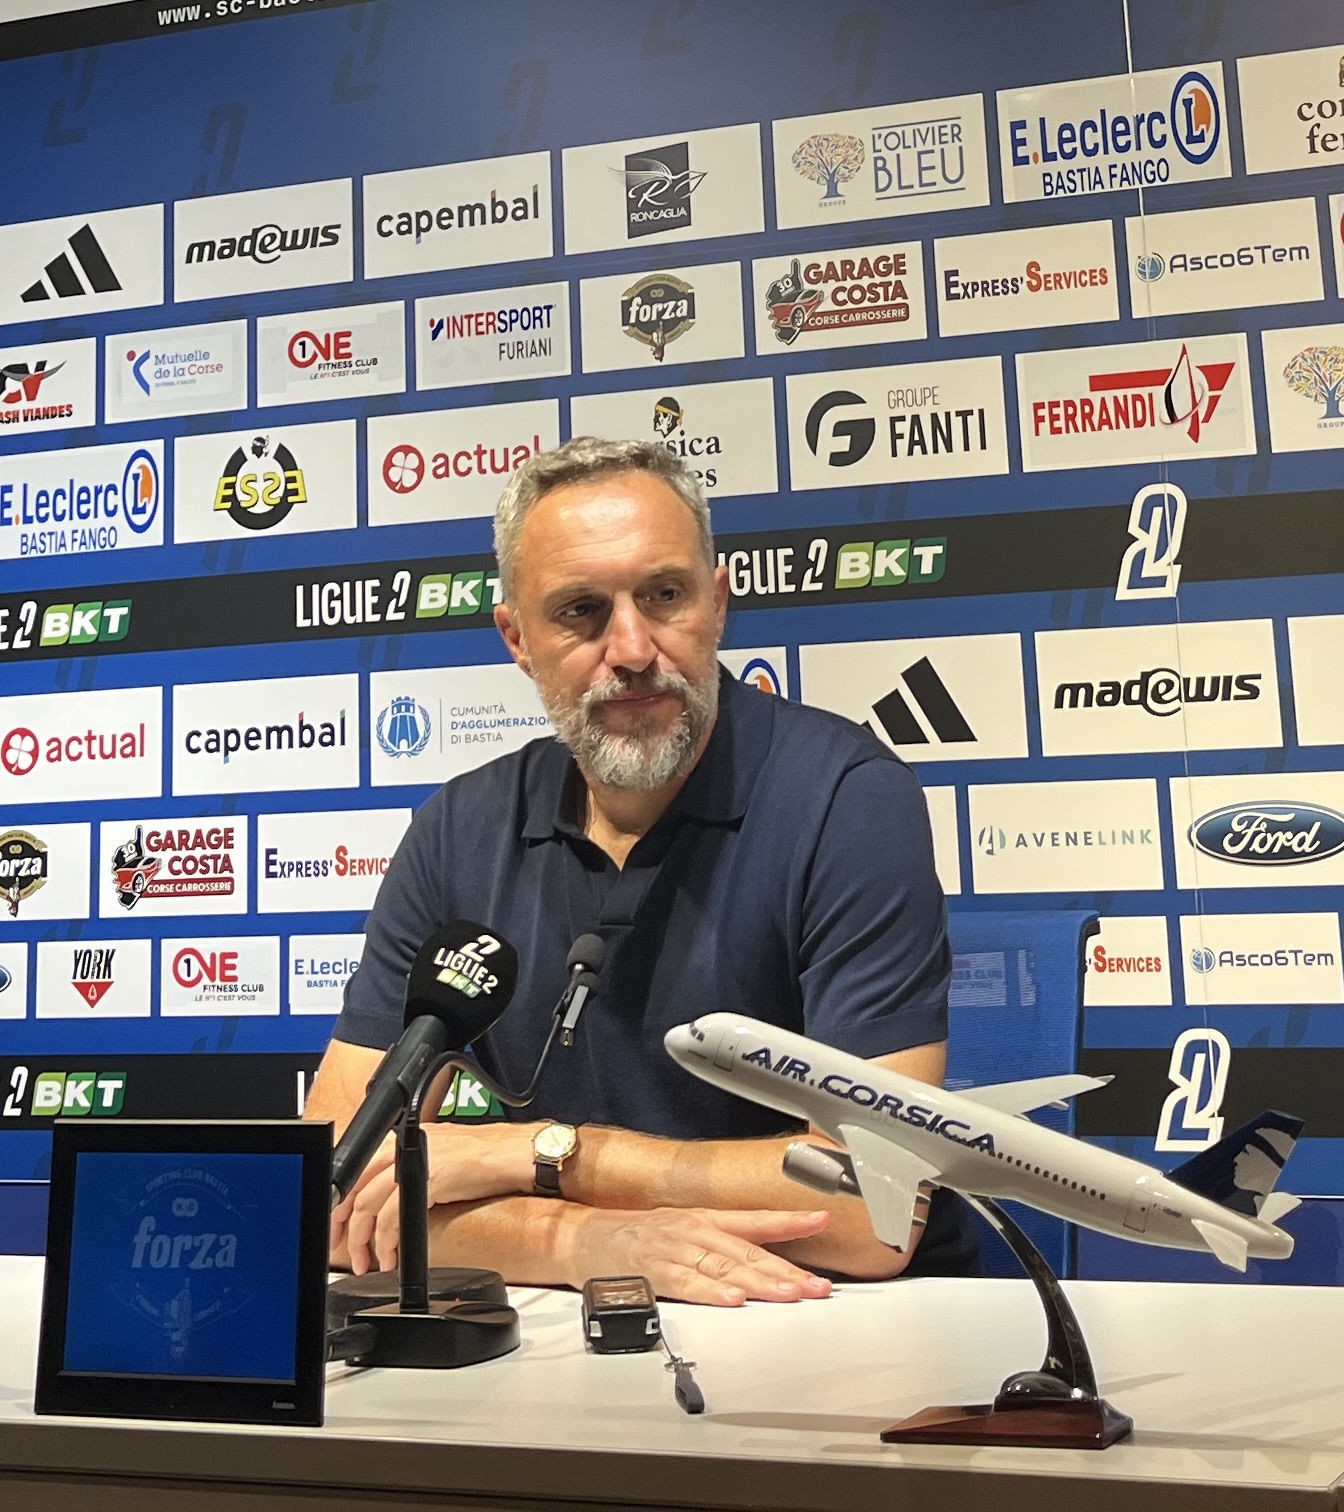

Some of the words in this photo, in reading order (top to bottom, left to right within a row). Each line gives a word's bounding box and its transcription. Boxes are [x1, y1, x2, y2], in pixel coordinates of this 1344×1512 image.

[872, 125, 962, 153] L'OLIVIER
[1009, 109, 1167, 167] E.Leclerc
[874, 145, 965, 193] BLEU
[1043, 165, 1104, 196] BASTIA
[1108, 157, 1170, 190] FANGO
[376, 184, 539, 244] capembal
[629, 205, 688, 226] RONCAGLIA
[185, 224, 341, 264] madewis
[804, 254, 906, 284] GARAGE
[1026, 261, 1108, 292] SERVICES
[628, 294, 688, 325] forza
[832, 281, 908, 307] COSTA
[446, 305, 553, 339] INTERSPORT
[809, 313, 839, 326] CORSE
[841, 308, 906, 322] CARROSSERIE
[154, 350, 210, 366] Mutuelle
[318, 362, 353, 371] FITNESS
[355, 358, 378, 368] CLUB
[499, 340, 552, 361] FURIANI
[188, 363, 223, 376] Corse
[887, 386, 940, 408] GROUPE
[22, 404, 73, 422] VIANDES
[1033, 392, 1155, 437] FERRANDI
[890, 408, 987, 458] FANTI
[0, 478, 118, 526] E.Leclerc
[20, 531, 67, 555] BASTIA
[71, 526, 117, 551] FANGO
[801, 539, 828, 591] 2
[838, 546, 943, 580] BKT
[296, 579, 380, 627] LIGUE
[386, 571, 411, 621] 2
[419, 578, 502, 609] BKT
[13, 601, 38, 648] 2
[41, 606, 128, 638] BKT
[1054, 668, 1262, 717] madewis
[450, 703, 506, 717] CUMUNITÀ
[46, 724, 145, 762] actual
[185, 709, 346, 764] capembal
[451, 735, 461, 744] DI
[465, 732, 503, 744] BASTIA
[145, 828, 235, 851] GARAGE
[1015, 827, 1153, 849] AVENELINK
[1223, 810, 1321, 854] Ford
[171, 853, 234, 876] COSTA
[147, 883, 172, 894] CORSE
[175, 879, 231, 894] CARROSSERIE
[73, 949, 116, 980] YORK
[433, 947, 489, 986] LIGUE
[482, 975, 499, 995] 2
[1093, 945, 1161, 974] SERVICES
[203, 984, 238, 993] FITNESS
[241, 983, 264, 992] CLUB
[307, 979, 338, 988] BASTIA
[3, 1066, 28, 1116] 2
[35, 1080, 123, 1107] BKT
[744, 1047, 812, 1083] AIR
[819, 1074, 996, 1158] CORSICA
[130, 1216, 238, 1270] forza
